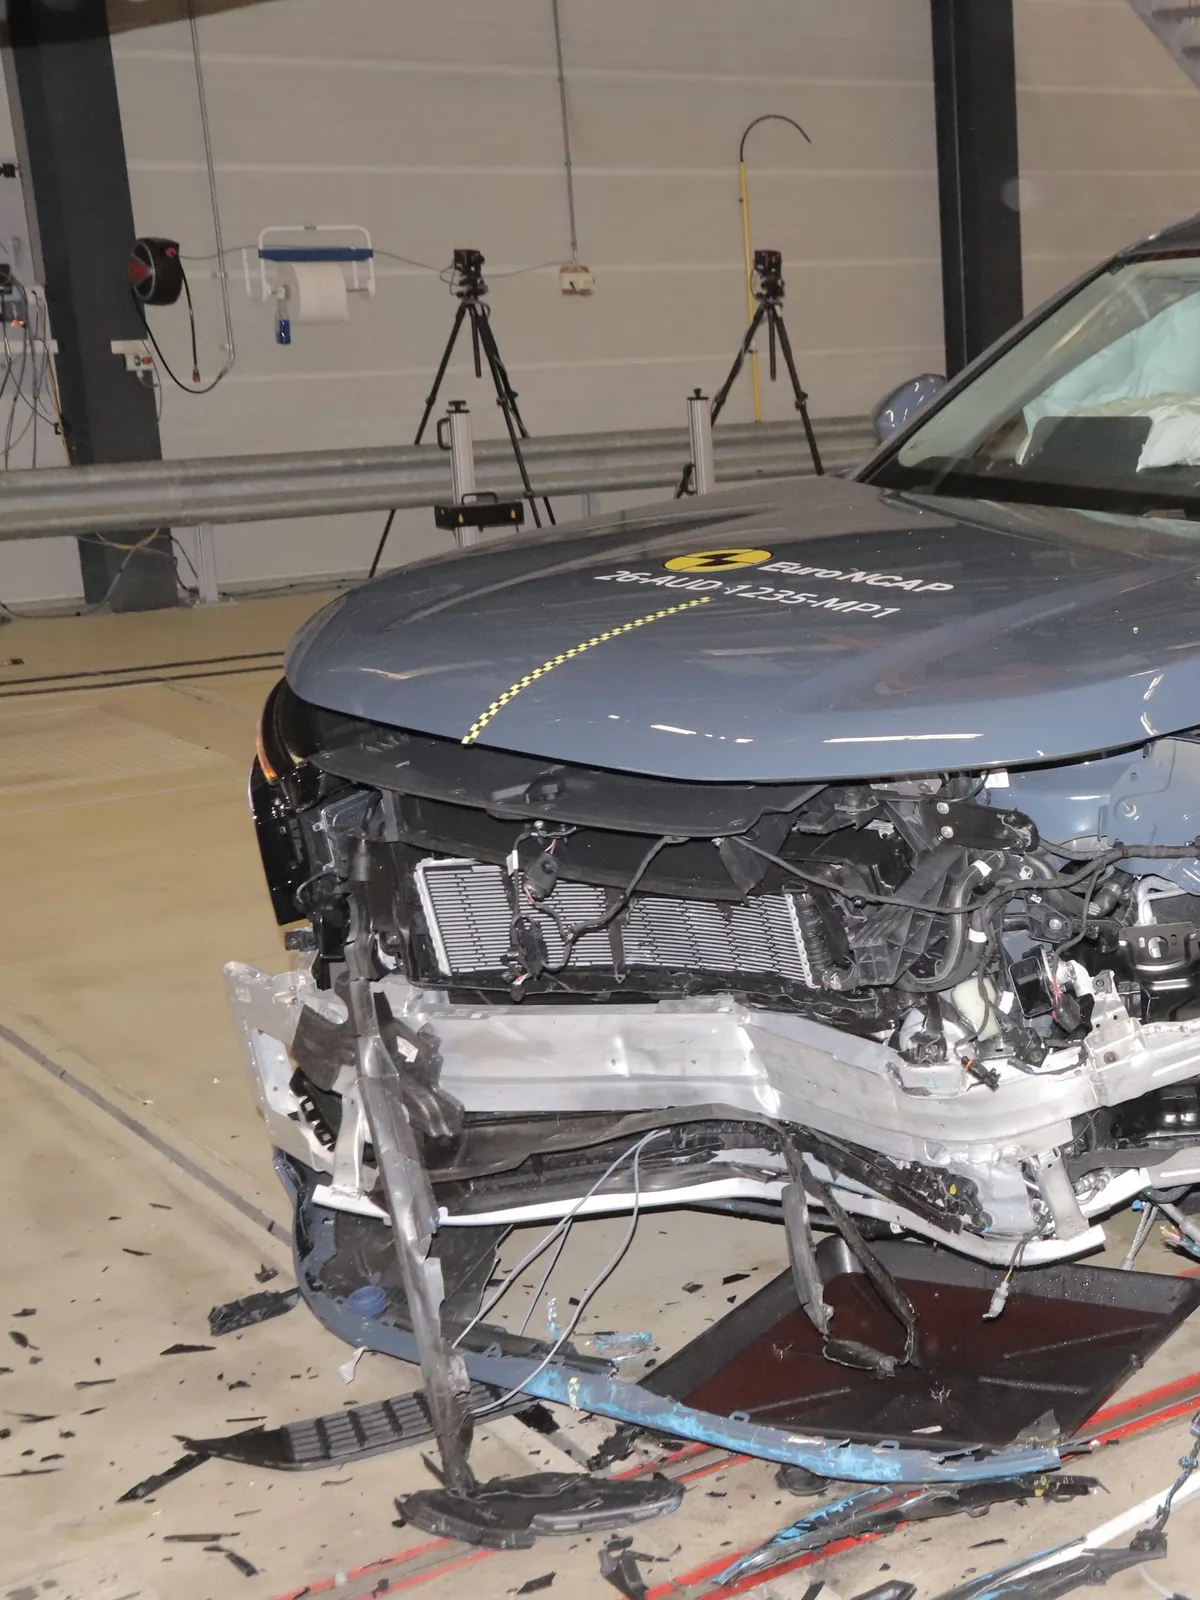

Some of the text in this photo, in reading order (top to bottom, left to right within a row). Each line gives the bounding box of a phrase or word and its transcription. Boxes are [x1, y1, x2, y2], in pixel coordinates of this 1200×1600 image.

[593, 570, 902, 619] 26-AUD-1235-MP1
[757, 560, 956, 594] Euro NCAP
